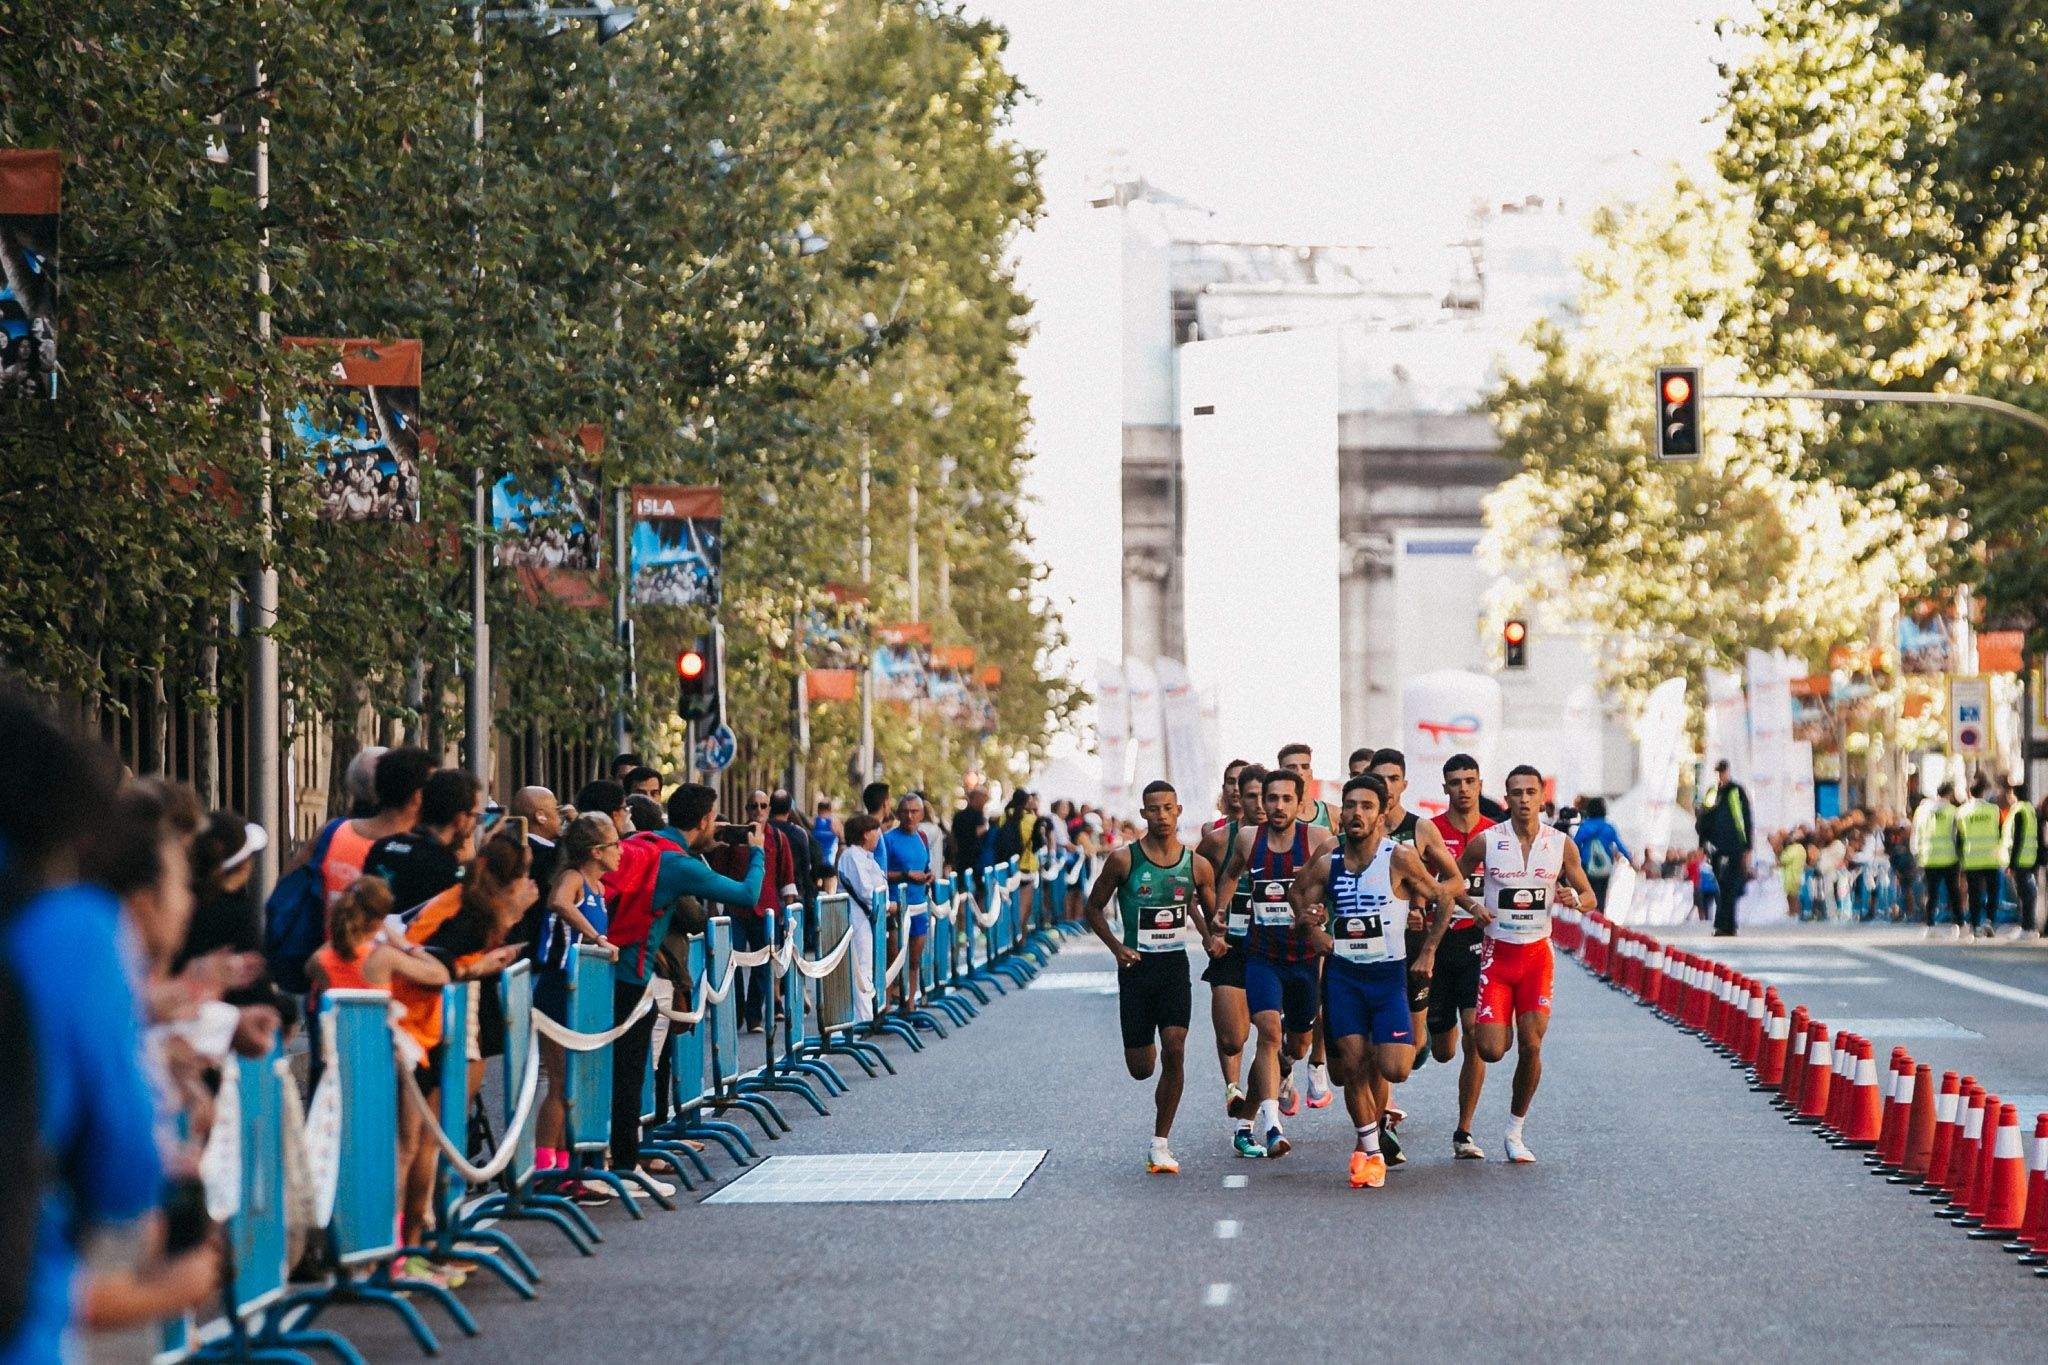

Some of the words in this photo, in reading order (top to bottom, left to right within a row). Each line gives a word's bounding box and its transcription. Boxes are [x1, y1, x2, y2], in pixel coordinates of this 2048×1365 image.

[1489, 867, 1528, 880] Puerto
[1534, 889, 1545, 901] 12
[1176, 907, 1183, 919] 5
[1368, 916, 1376, 929] 1
[1151, 932, 1176, 940] RONALDO
